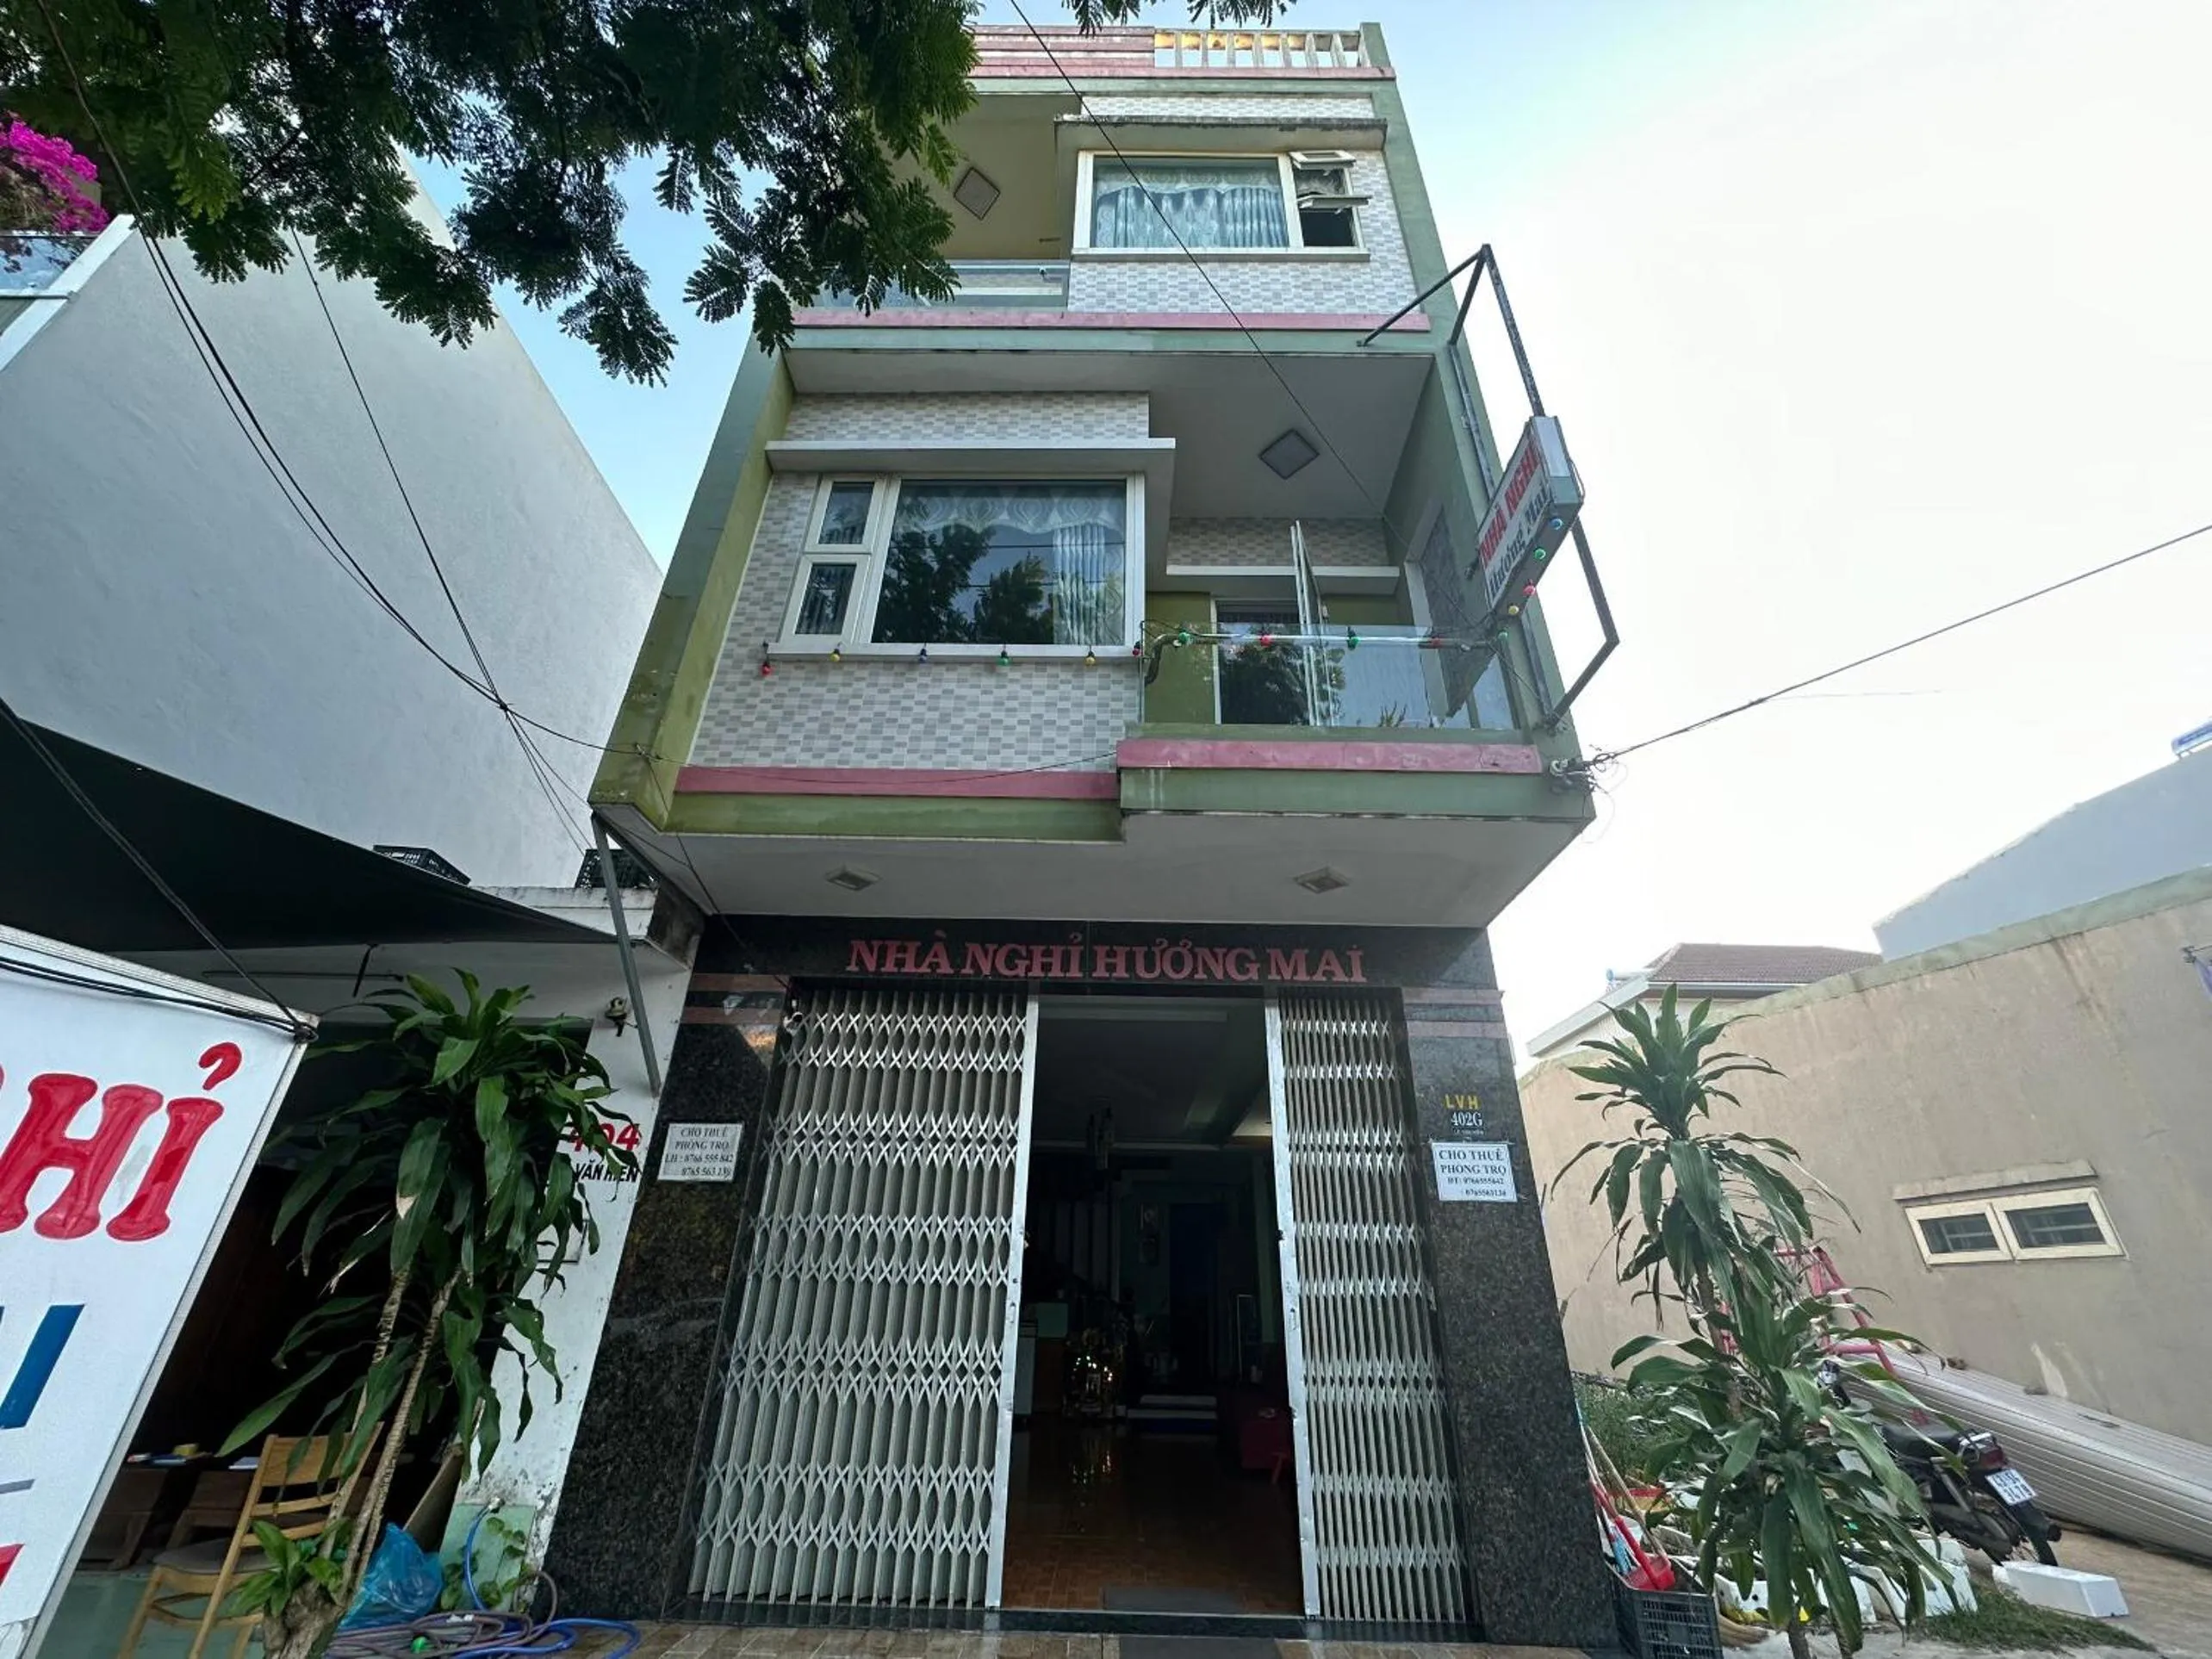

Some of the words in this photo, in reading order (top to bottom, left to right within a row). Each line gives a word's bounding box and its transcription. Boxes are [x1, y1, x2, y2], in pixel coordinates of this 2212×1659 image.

[846, 929, 954, 974] NHÀ
[960, 931, 1084, 978] NGHỈ
[1091, 937, 1260, 980] HƯỞNG
[1266, 944, 1368, 983] MAI
[1445, 1093, 1479, 1109] LVH
[1451, 1111, 1483, 1127] 402G
[680, 1127, 702, 1137] CHO
[0, 1041, 242, 1241] HỈ
[1438, 1150, 1466, 1159] CHO
